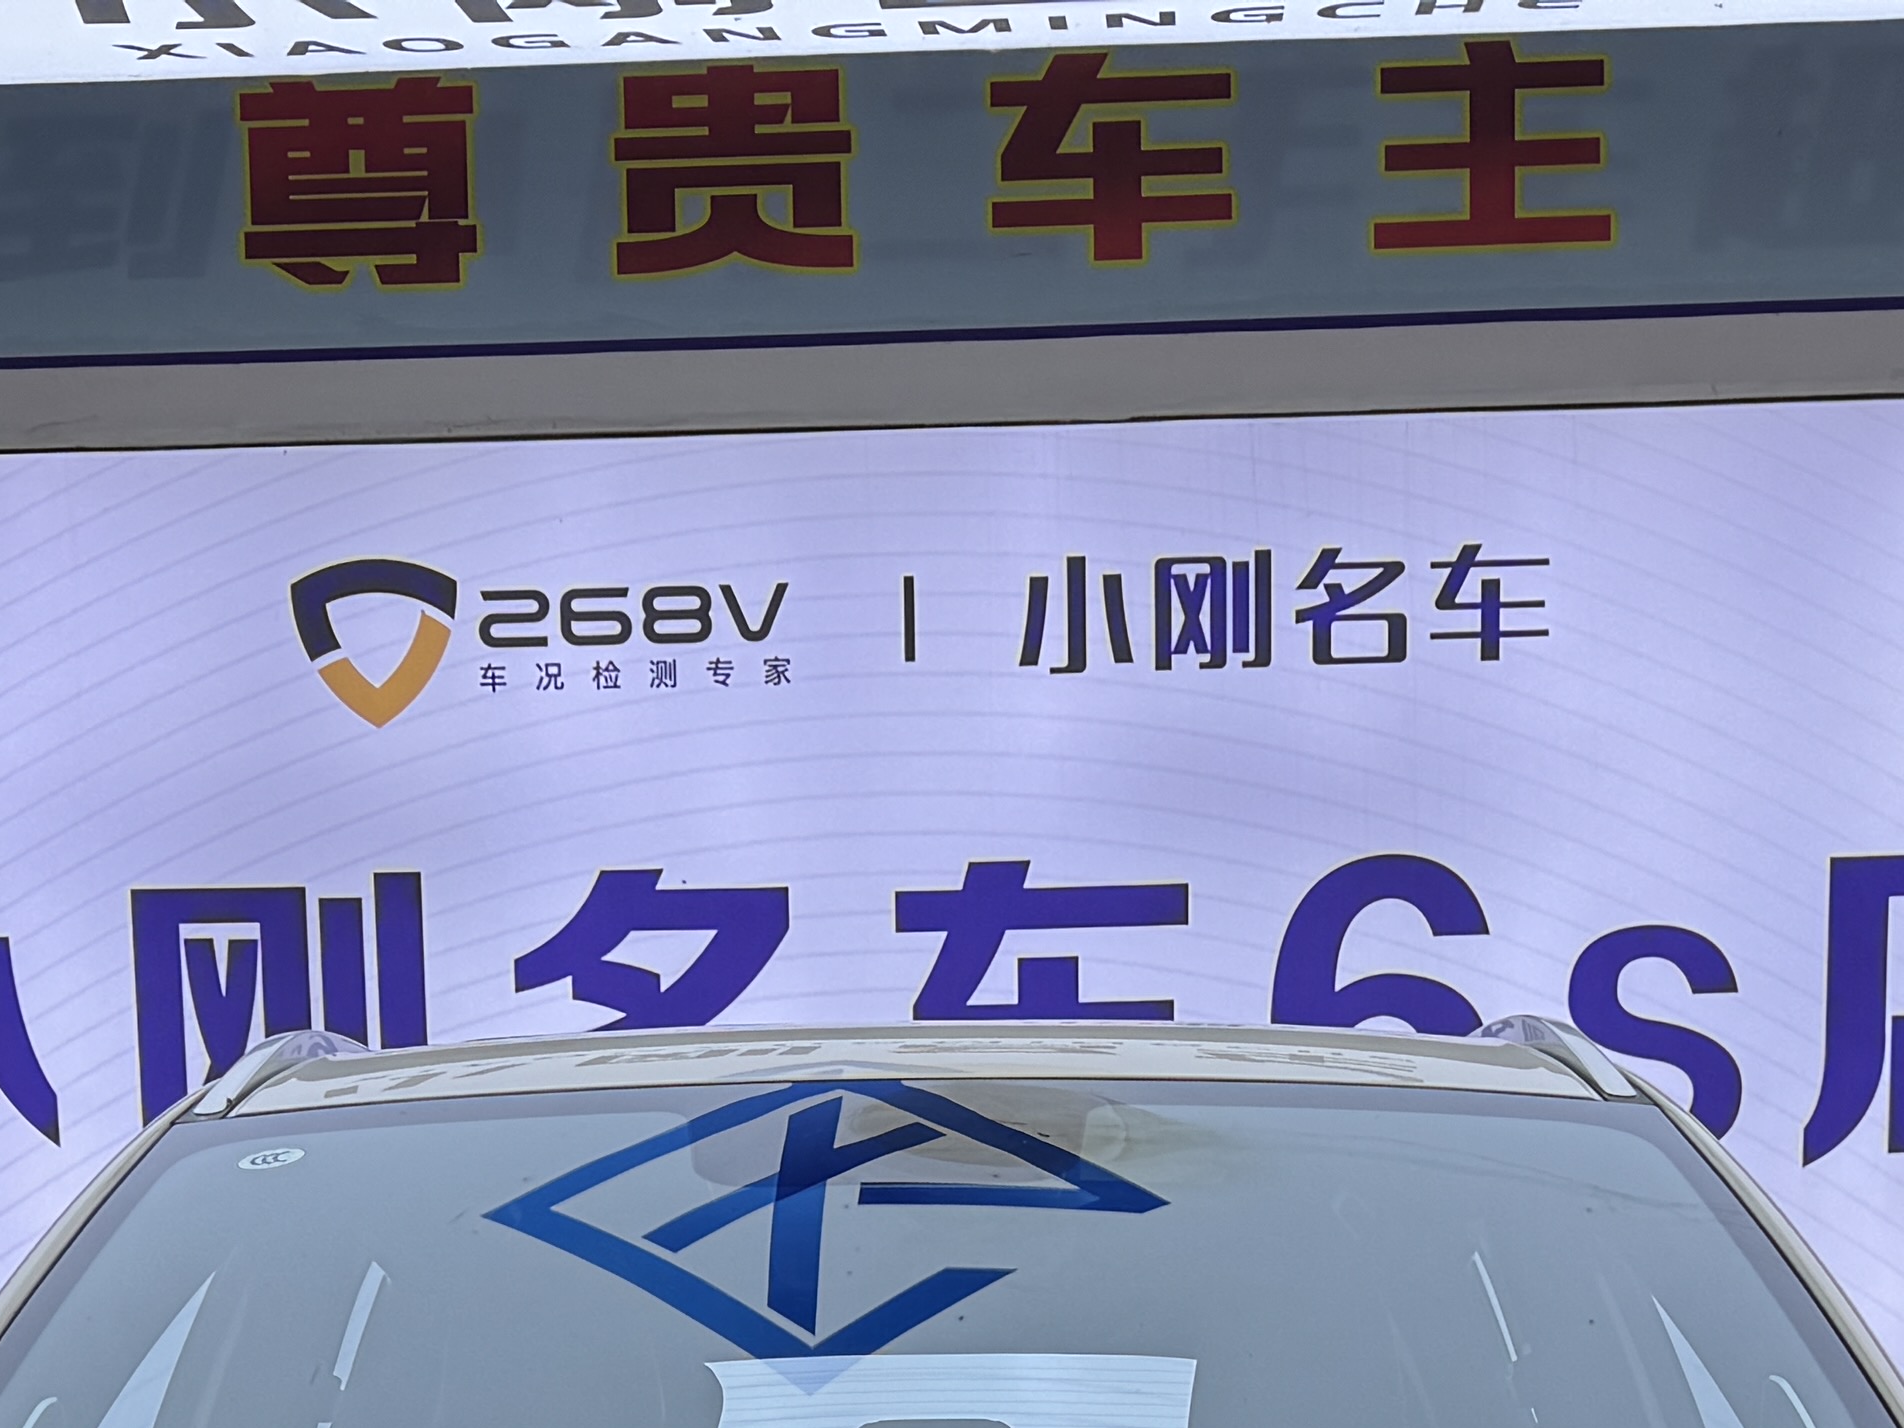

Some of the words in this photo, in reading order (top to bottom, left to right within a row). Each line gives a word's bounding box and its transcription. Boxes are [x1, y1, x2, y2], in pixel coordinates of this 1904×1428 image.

[233, 38, 1616, 290] 尊贵车主
[478, 582, 790, 649] 268V
[1017, 542, 1551, 676] 小刚名车
[478, 655, 793, 695] 车况检测专家
